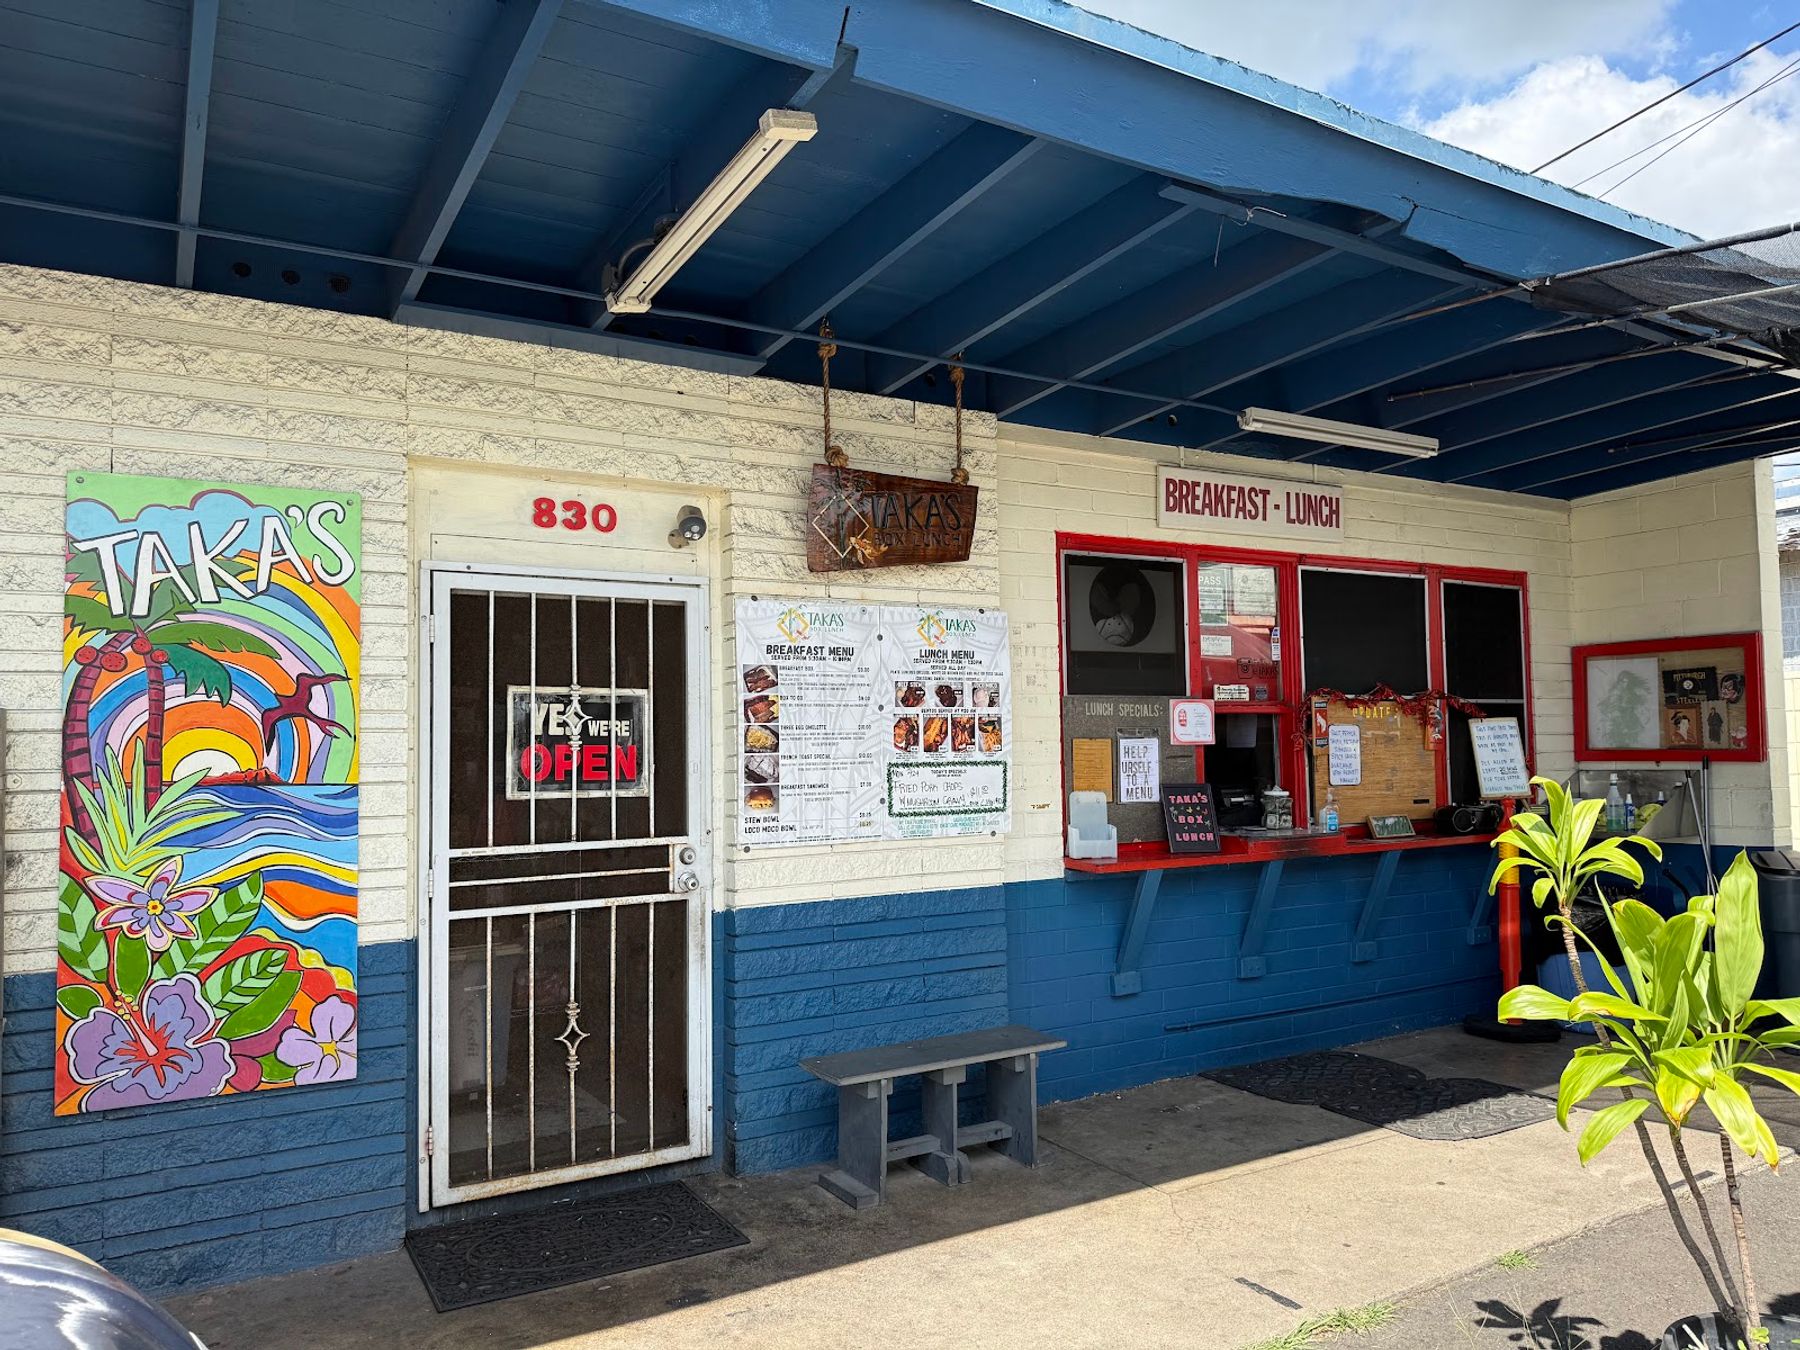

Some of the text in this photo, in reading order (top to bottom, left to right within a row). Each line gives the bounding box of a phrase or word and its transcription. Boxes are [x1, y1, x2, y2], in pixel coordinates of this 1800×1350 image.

[1165, 477, 1270, 521] BREAKFAST
[1285, 491, 1340, 528] LUNCH
[532, 497, 618, 533] 830
[871, 493, 962, 530] TAKA'S
[873, 531, 962, 547] BOX LUNCH
[72, 500, 356, 619] TAKA'S
[1199, 575, 1222, 585] PASS
[766, 644, 854, 657] BREAKFAST MENU
[919, 649, 975, 660] LUNCH MENU
[1085, 702, 1164, 718] LUNCH SPECIALS:
[588, 720, 630, 737] WE'RE
[1123, 745, 1148, 760] HELP
[520, 744, 637, 782] OPEN
[1121, 760, 1152, 774] URSELF
[894, 780, 918, 794] FRIED
[1126, 773, 1150, 787] TO A
[1126, 787, 1153, 801] MENU
[1168, 792, 1209, 804] TAKA'S
[763, 815, 780, 823] BOWL
[1177, 814, 1204, 824] BOX
[762, 825, 779, 833] MOCO
[780, 824, 797, 832] BOWL
[1175, 832, 1214, 842] LUNCH
